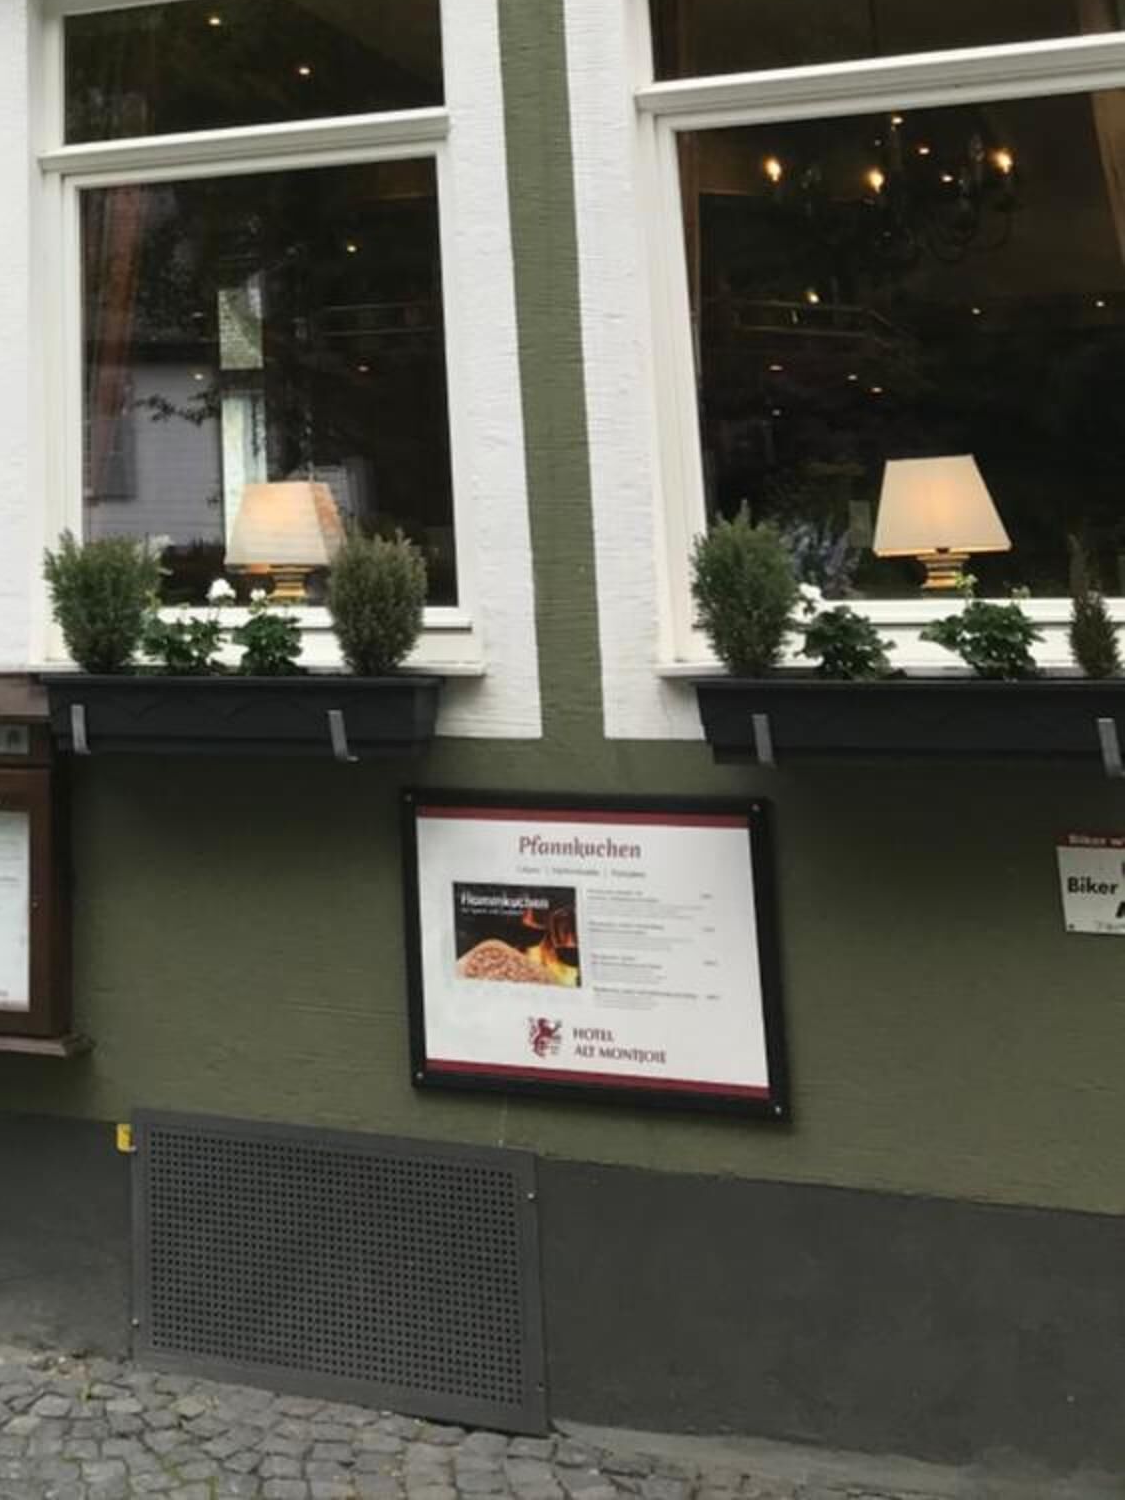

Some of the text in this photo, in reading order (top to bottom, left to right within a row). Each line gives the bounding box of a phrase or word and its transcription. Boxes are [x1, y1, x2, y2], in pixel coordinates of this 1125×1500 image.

[518, 834, 642, 859] Pfannkuchen
[1067, 876, 1118, 895] Biker
[572, 1027, 615, 1042] HOTEL
[574, 1043, 667, 1064] ALT MONTJOIE
